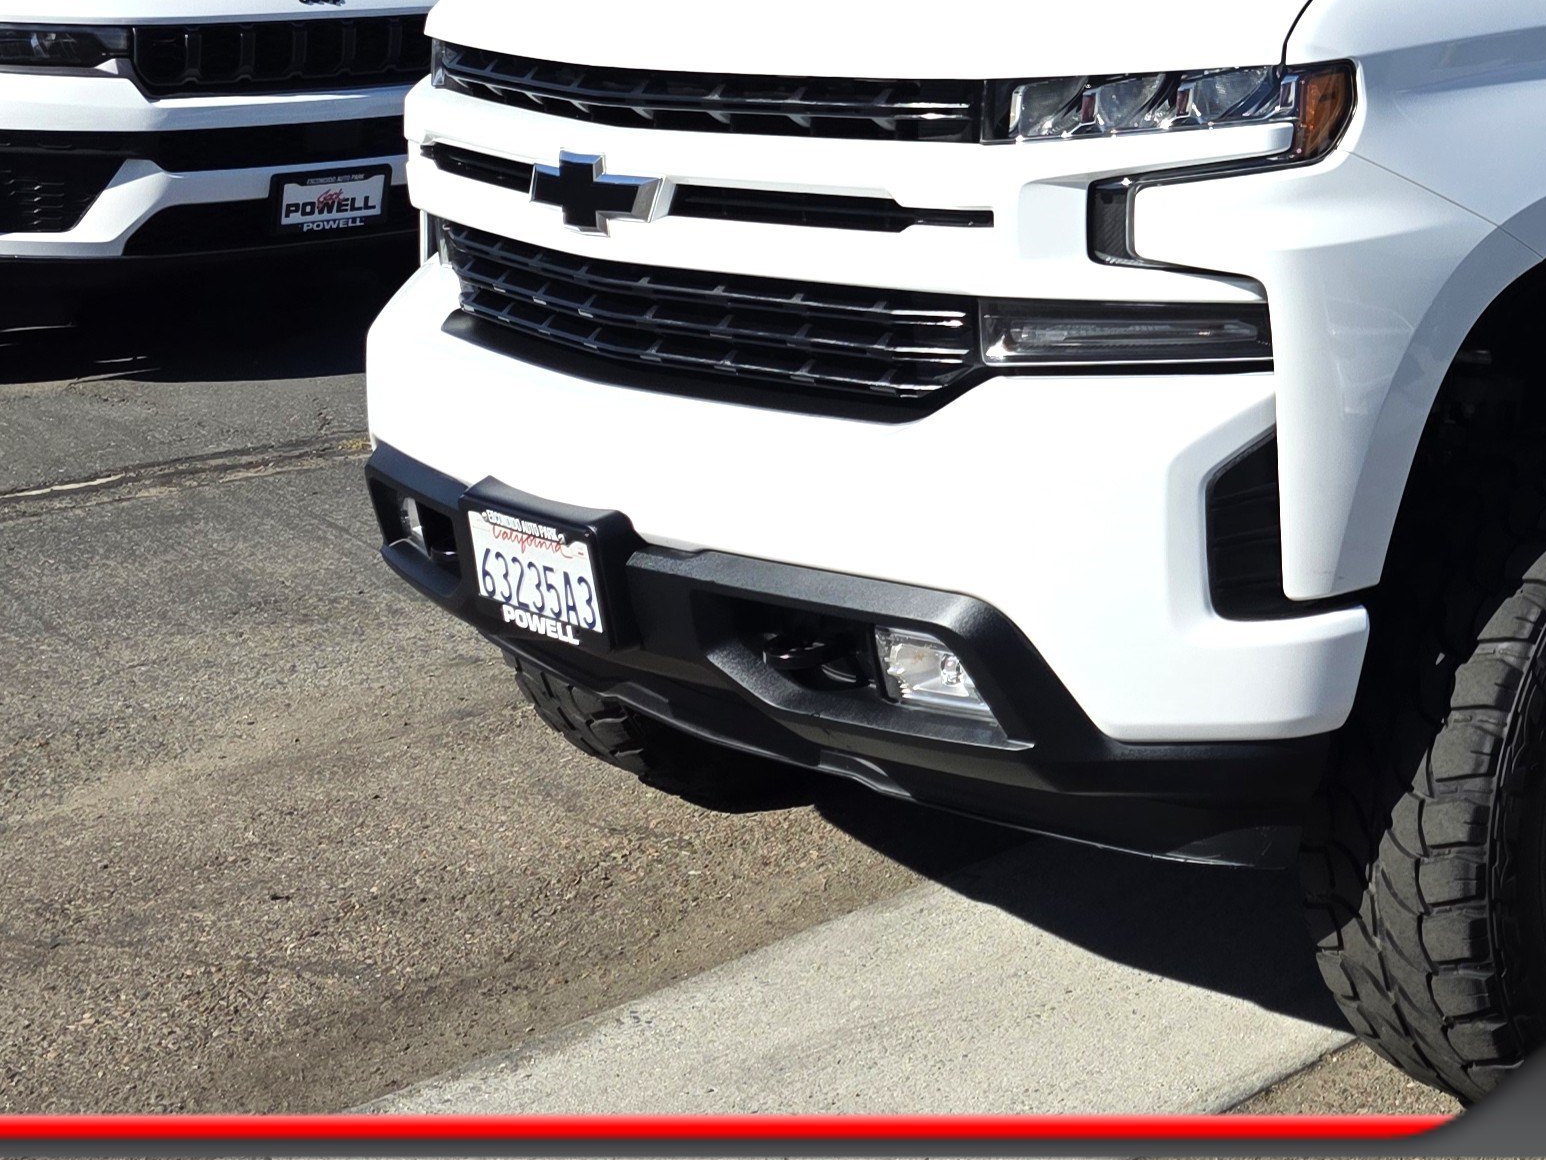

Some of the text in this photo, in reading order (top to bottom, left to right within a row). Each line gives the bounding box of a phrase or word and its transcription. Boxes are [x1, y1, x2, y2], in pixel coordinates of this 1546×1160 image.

[285, 196, 376, 218] POWELL
[303, 217, 364, 232] POWELL
[521, 520, 540, 537] AUTO
[538, 524, 560, 542] PARK
[481, 547, 597, 630] 63235A3
[502, 603, 581, 646] POWELL
